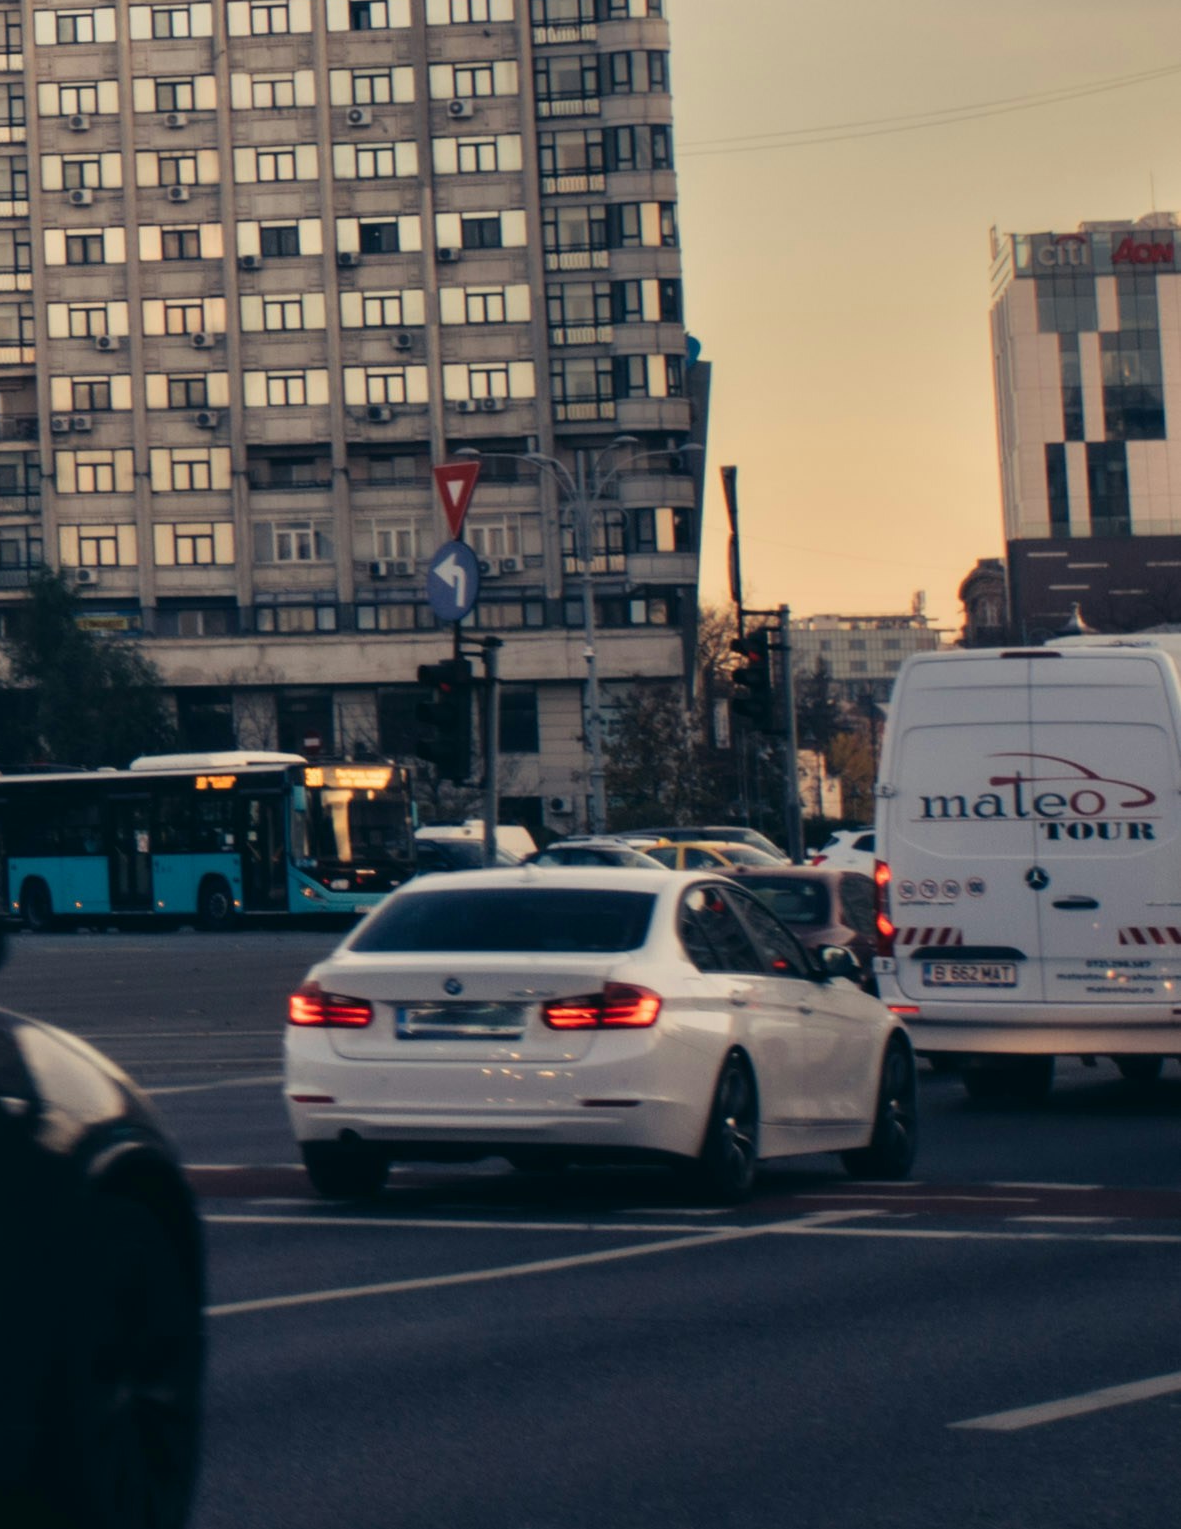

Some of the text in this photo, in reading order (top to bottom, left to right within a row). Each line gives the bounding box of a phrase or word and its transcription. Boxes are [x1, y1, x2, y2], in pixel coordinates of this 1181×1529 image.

[1038, 237, 1090, 267] citi
[920, 770, 1107, 818] mateo
[1040, 821, 1156, 841] TOUR
[934, 966, 946, 981] B
